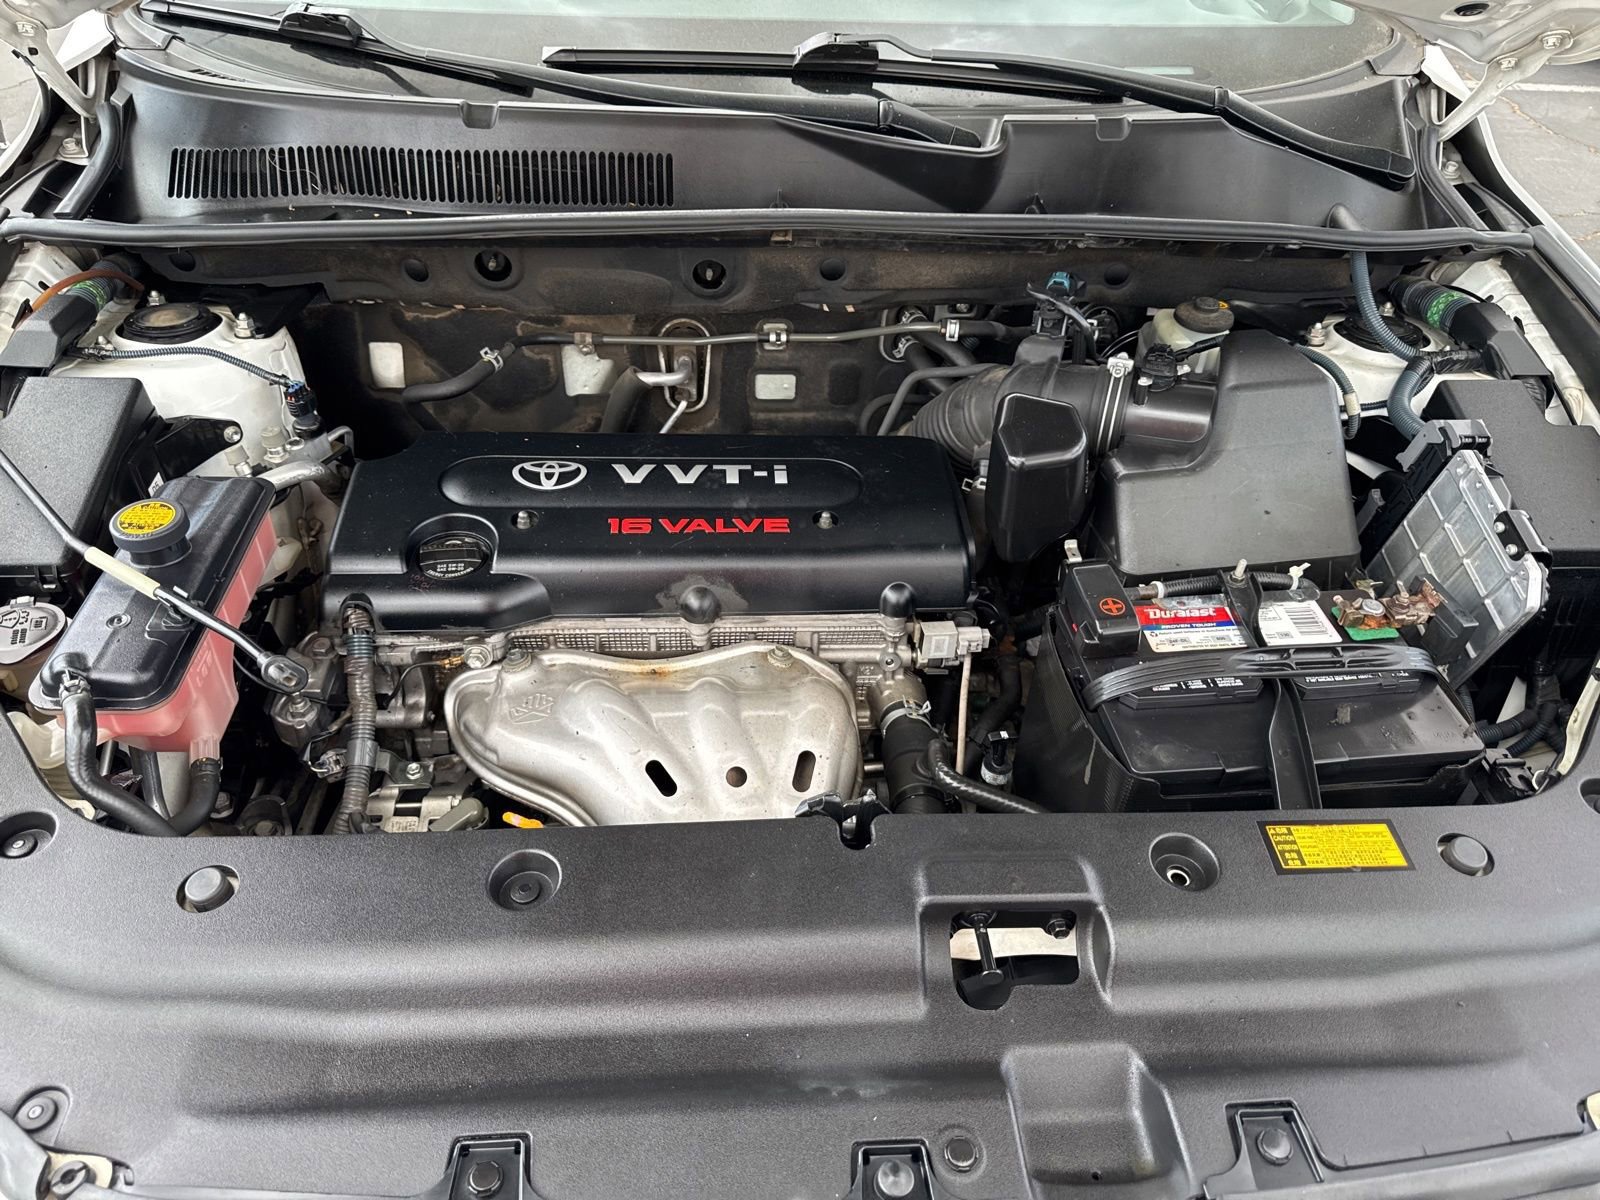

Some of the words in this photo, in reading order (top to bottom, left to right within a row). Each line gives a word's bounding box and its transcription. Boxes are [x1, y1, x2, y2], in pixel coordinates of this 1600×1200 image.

[611, 464, 788, 484] VVT-i
[608, 518, 652, 534] 16
[658, 518, 791, 534] VALVE
[1144, 607, 1217, 619] Duralast
